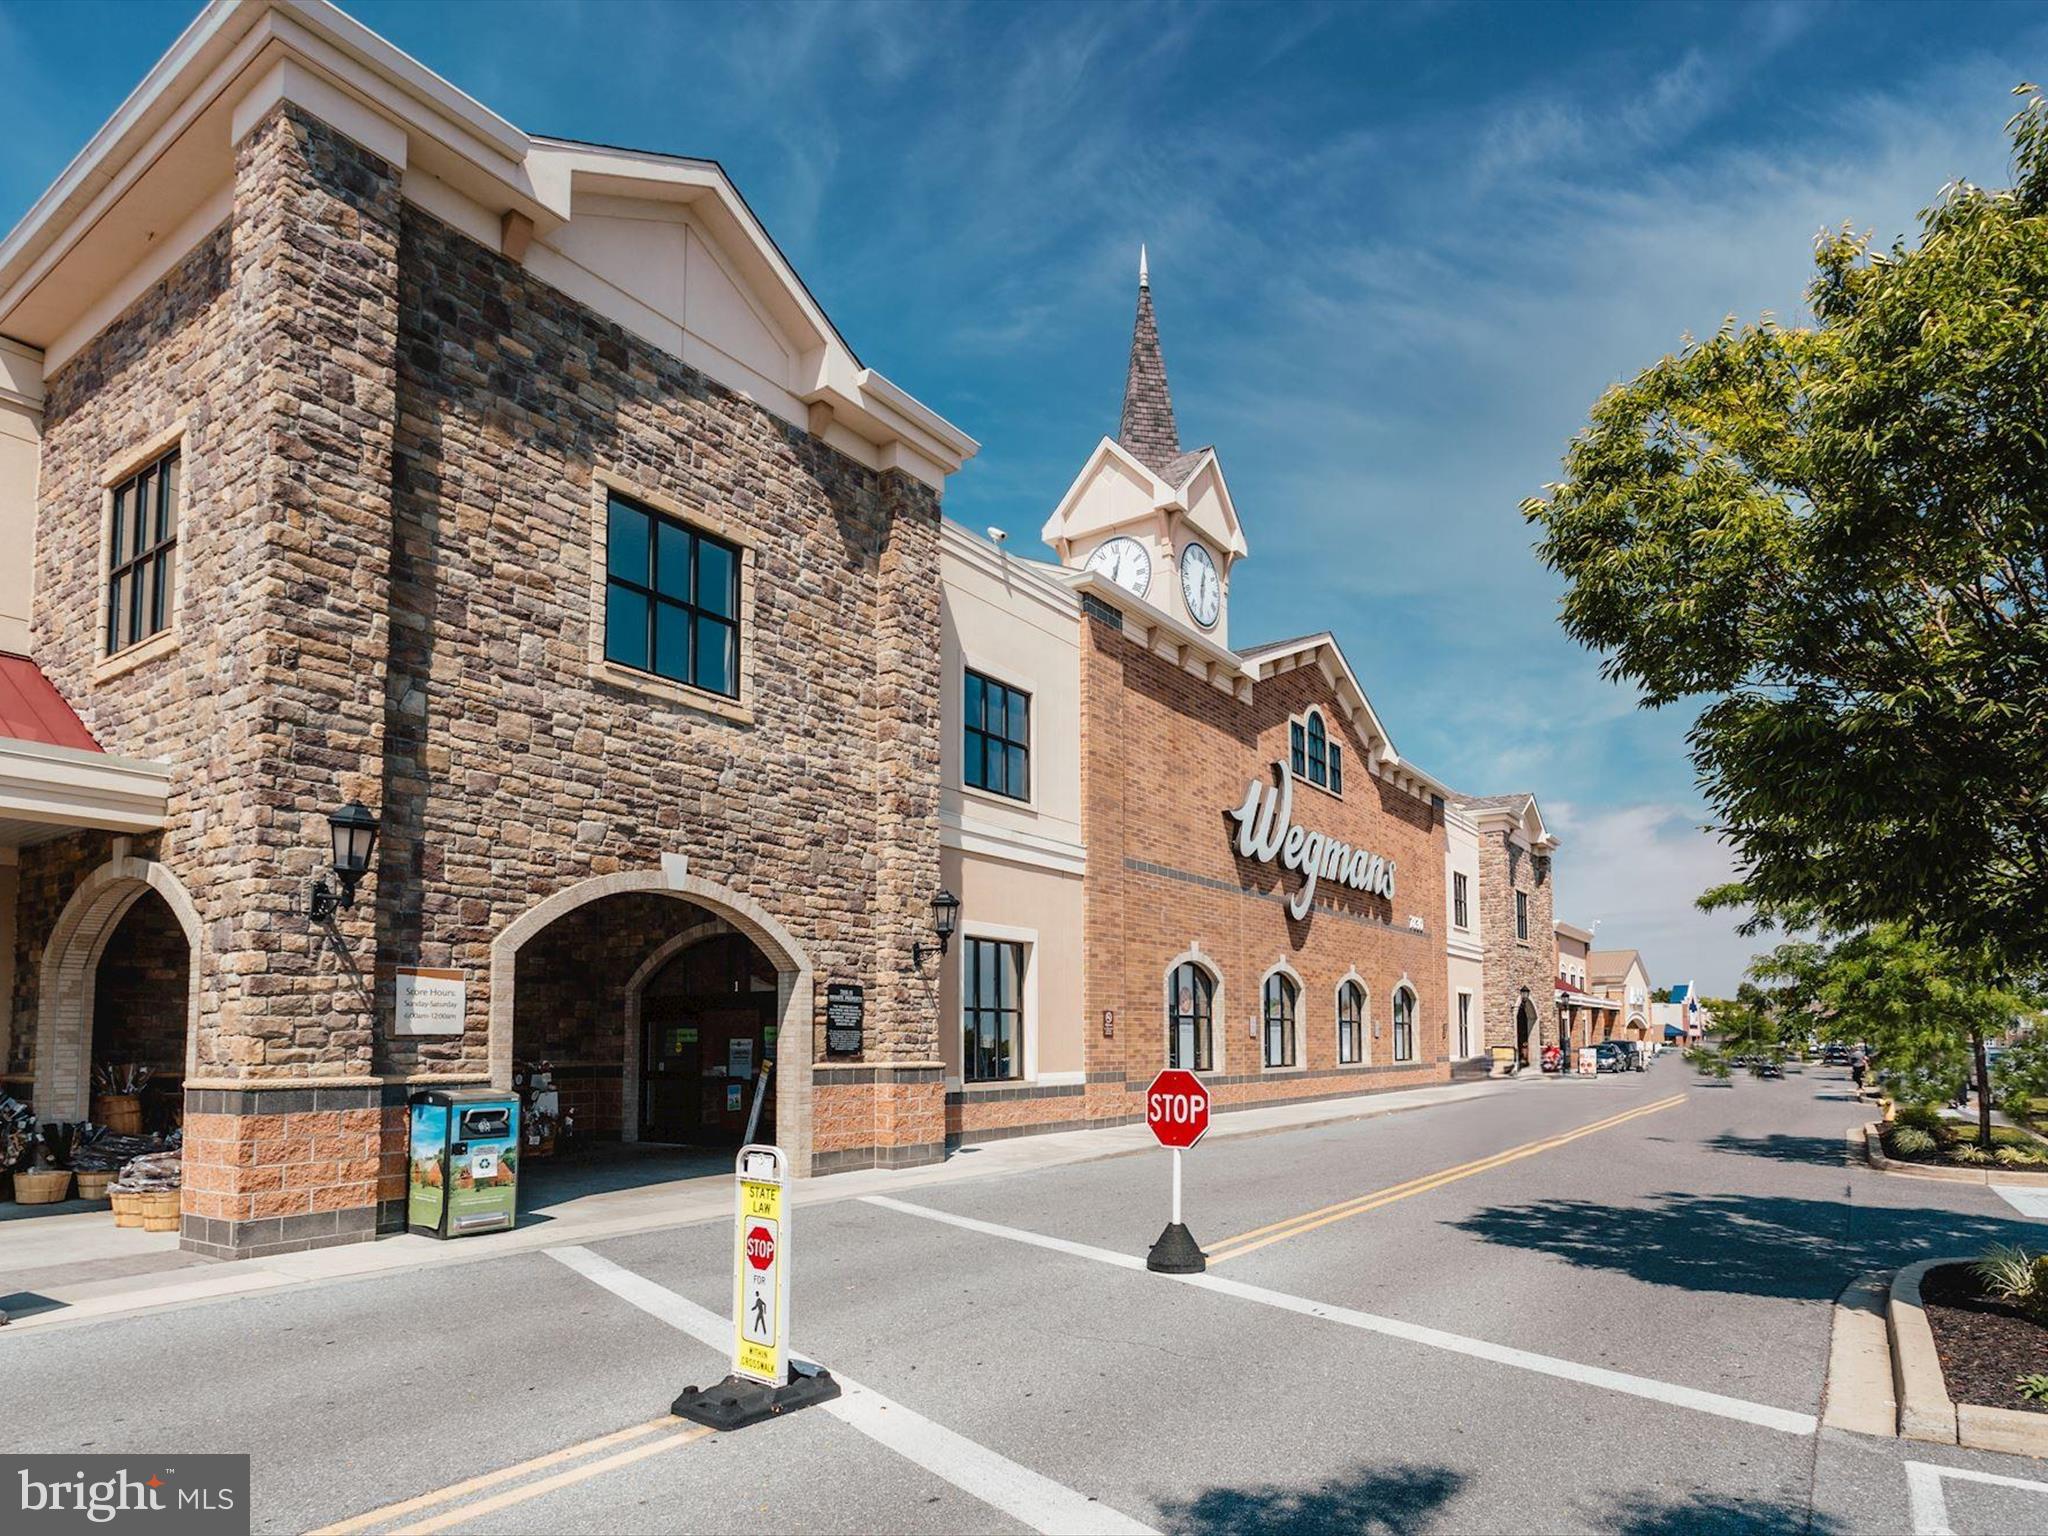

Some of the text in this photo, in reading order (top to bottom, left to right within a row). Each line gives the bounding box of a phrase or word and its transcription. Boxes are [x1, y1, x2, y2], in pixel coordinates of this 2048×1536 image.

[1230, 760, 1396, 921] Wegmans
[406, 987, 428, 997] Store
[1149, 1093, 1206, 1124] STOP
[749, 1186, 776, 1201] STATE
[752, 1201, 771, 1214] LAW
[747, 1238, 774, 1259] STOP
[753, 1274, 766, 1286] FOR
[741, 1356, 775, 1374] CROSSWALK
